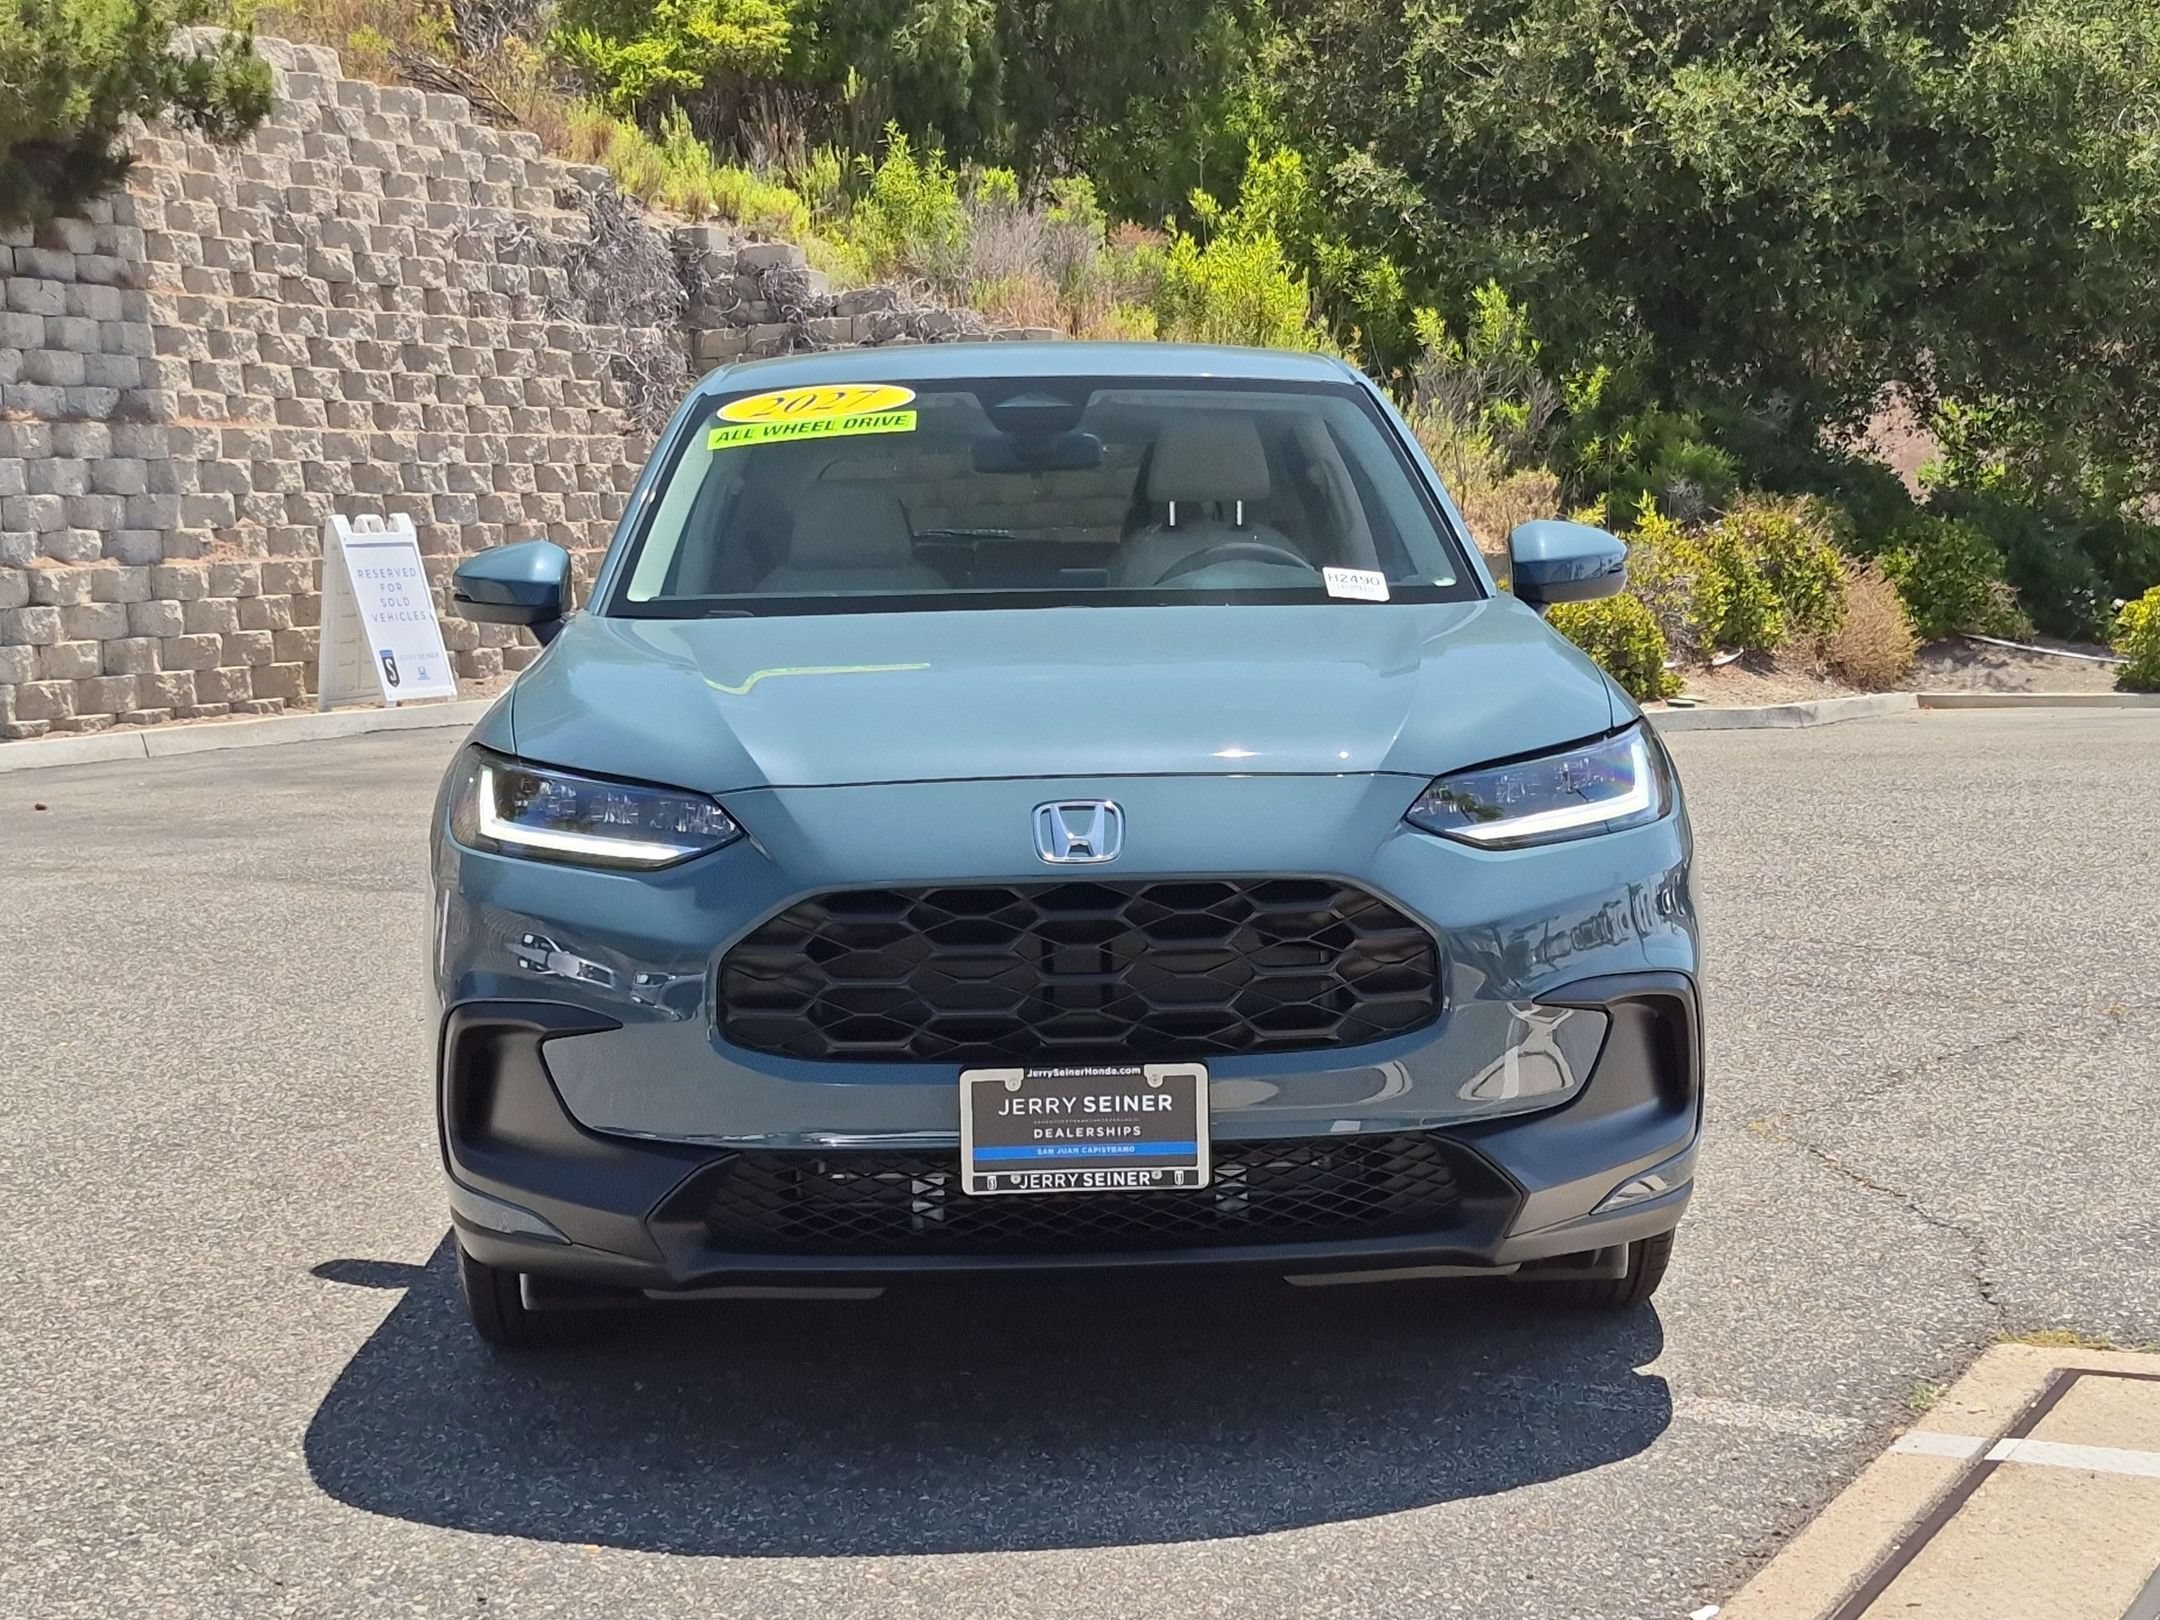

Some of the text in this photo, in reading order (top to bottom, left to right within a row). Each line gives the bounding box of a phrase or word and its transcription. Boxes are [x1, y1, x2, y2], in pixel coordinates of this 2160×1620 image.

[750, 390, 880, 417] 2027
[715, 414, 908, 443] ALL WHEEL DRIVE
[357, 567, 417, 579] RESERVED
[1328, 573, 1380, 586] H2490
[380, 583, 403, 593] FOR
[380, 597, 410, 607] SOLD
[371, 611, 427, 622] VEHICLES
[1026, 1067, 1141, 1078] JerrySeinerHonda.com
[998, 1094, 1173, 1116] JERRY SEINER
[1033, 1126, 1141, 1139] DEALERSHIPS
[1057, 1147, 1079, 1155] JUAN
[1019, 1171, 1151, 1189] JERRY SEINER
